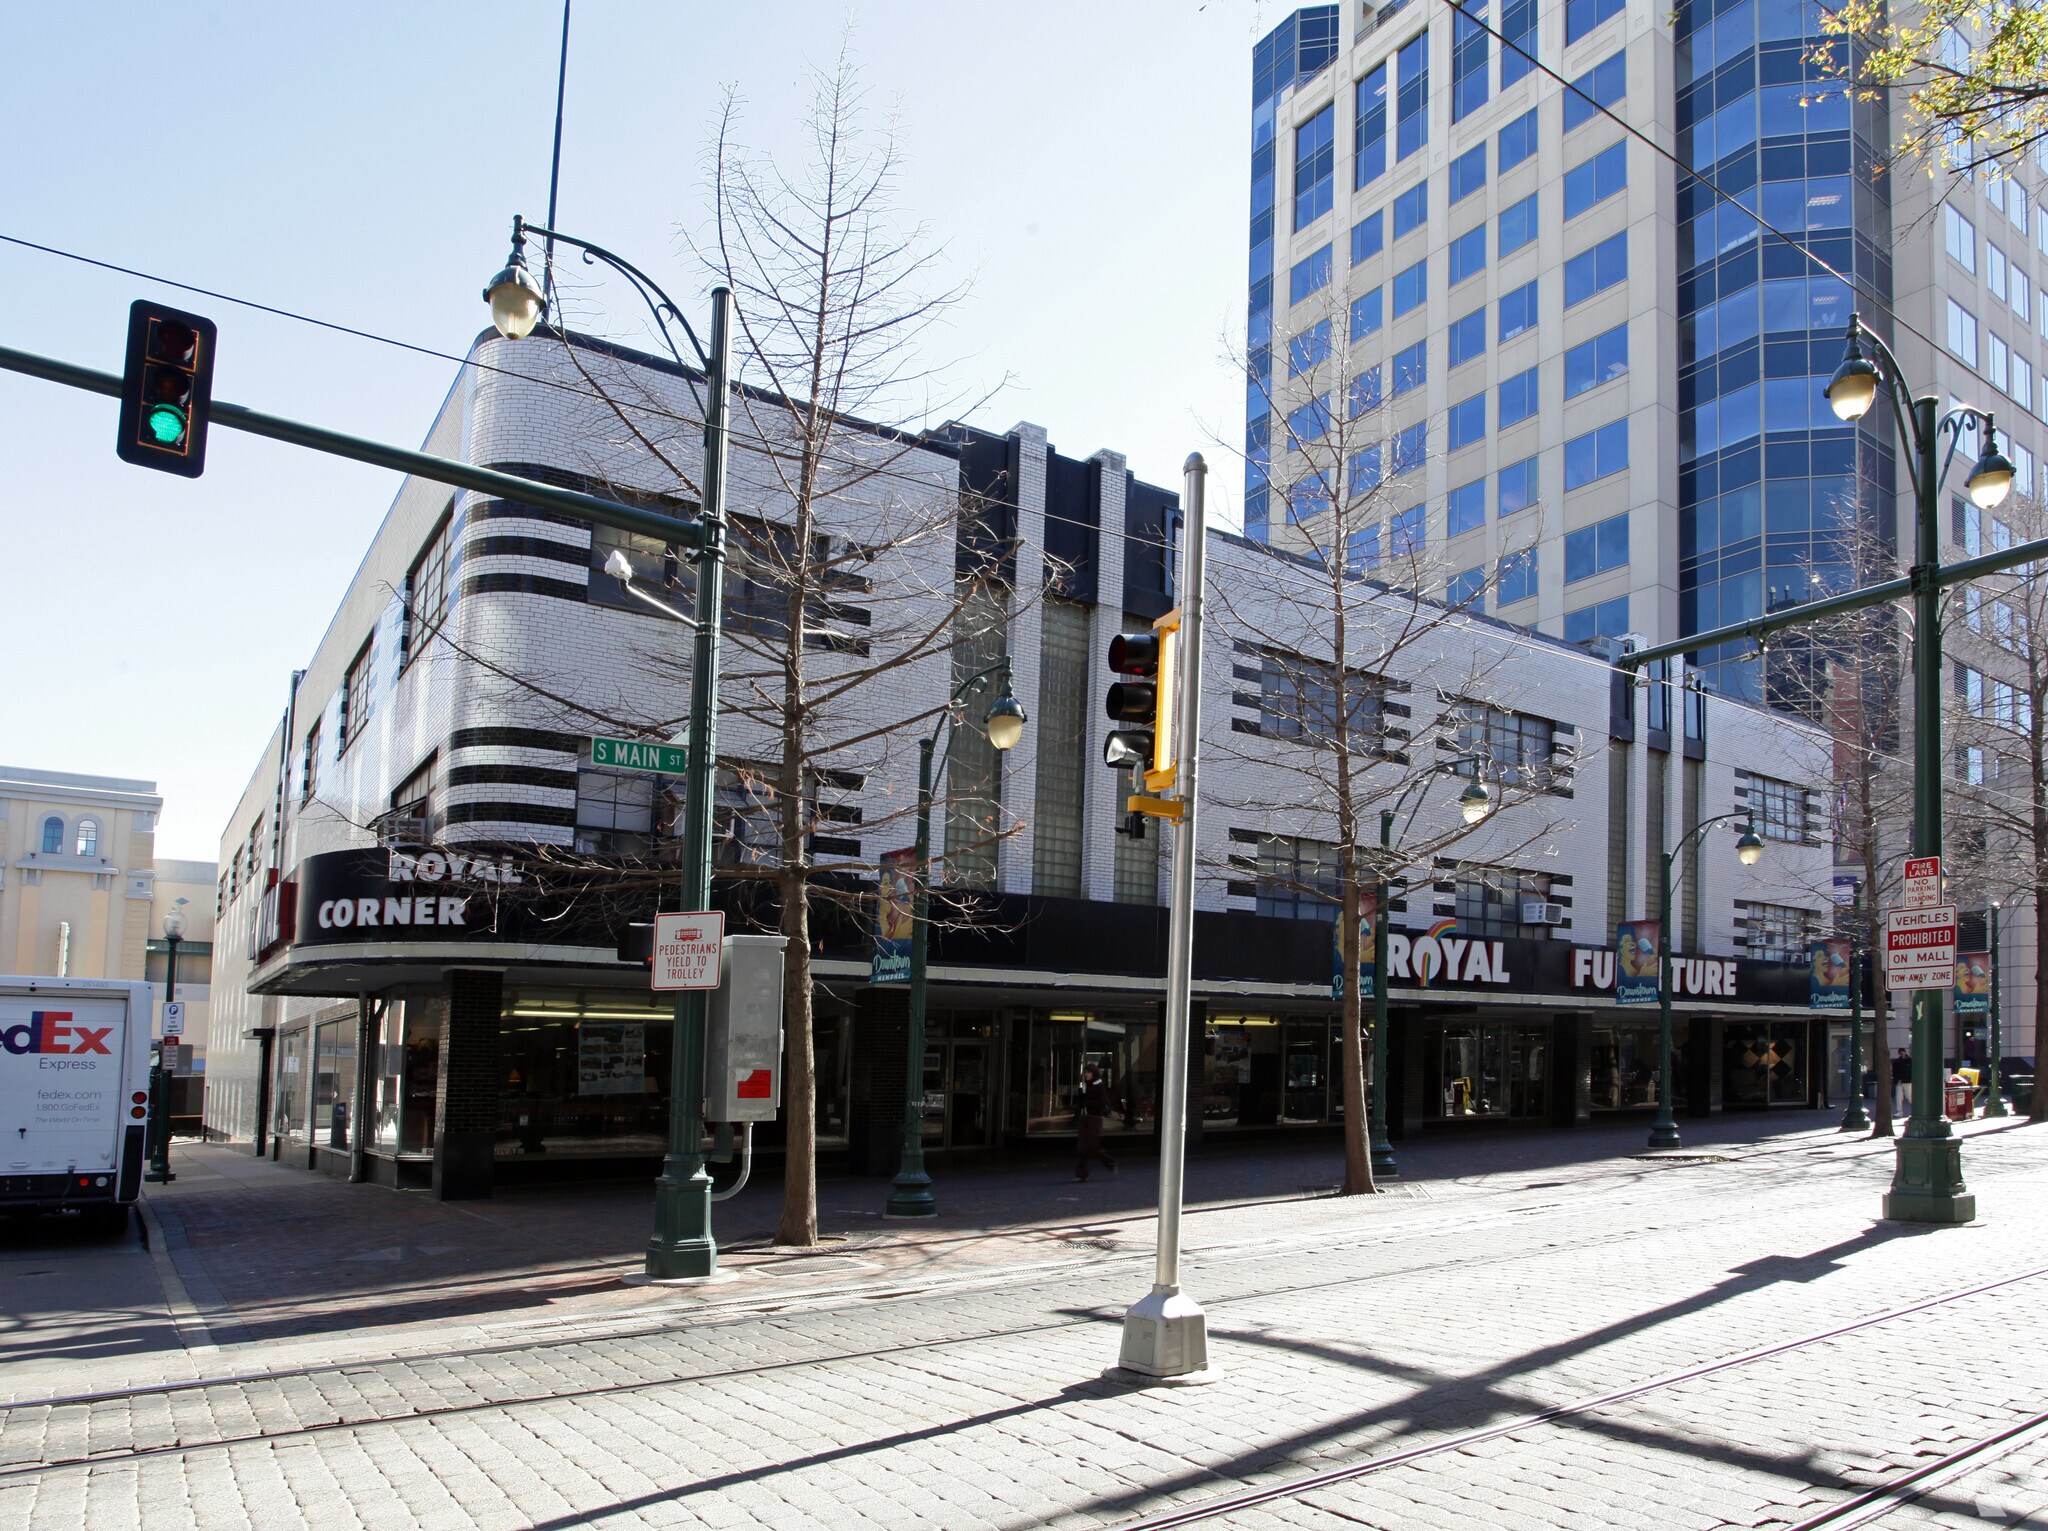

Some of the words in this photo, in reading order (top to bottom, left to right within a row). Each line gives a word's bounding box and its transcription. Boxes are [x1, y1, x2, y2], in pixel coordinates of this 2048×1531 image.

[597, 742, 607, 760] S
[614, 743, 660, 769] MAIN
[669, 755, 681, 766] ST
[389, 851, 522, 883] ROYAL
[1909, 868, 1934, 877] LANE
[1911, 862, 1932, 870] FIRE
[1907, 885, 1936, 893] PARKING
[1907, 894, 1936, 904] STANDING
[318, 897, 467, 929] CORNER
[1895, 912, 1949, 926] VEHICLES
[1892, 930, 1951, 947] PROHIBITED
[659, 943, 717, 956] PEDESTRIANS
[667, 956, 691, 967] YIELD
[697, 956, 707, 966] TO
[1893, 954, 1908, 964] ON
[1917, 951, 1949, 962] MALL
[1387, 934, 1510, 983] ROYAL
[1575, 949, 1737, 996] FUTURE
[667, 968, 704, 979] TROLLEY
[877, 973, 905, 981] MEMPHIS
[1891, 973, 1928, 982] TOW-AWAY
[1932, 971, 1951, 980] ZONE
[1617, 983, 1657, 999] Downtown
[1810, 991, 1848, 1004] Downtown
[39, 1058, 96, 1071] Express
[37, 1090, 101, 1100] fedex.com
